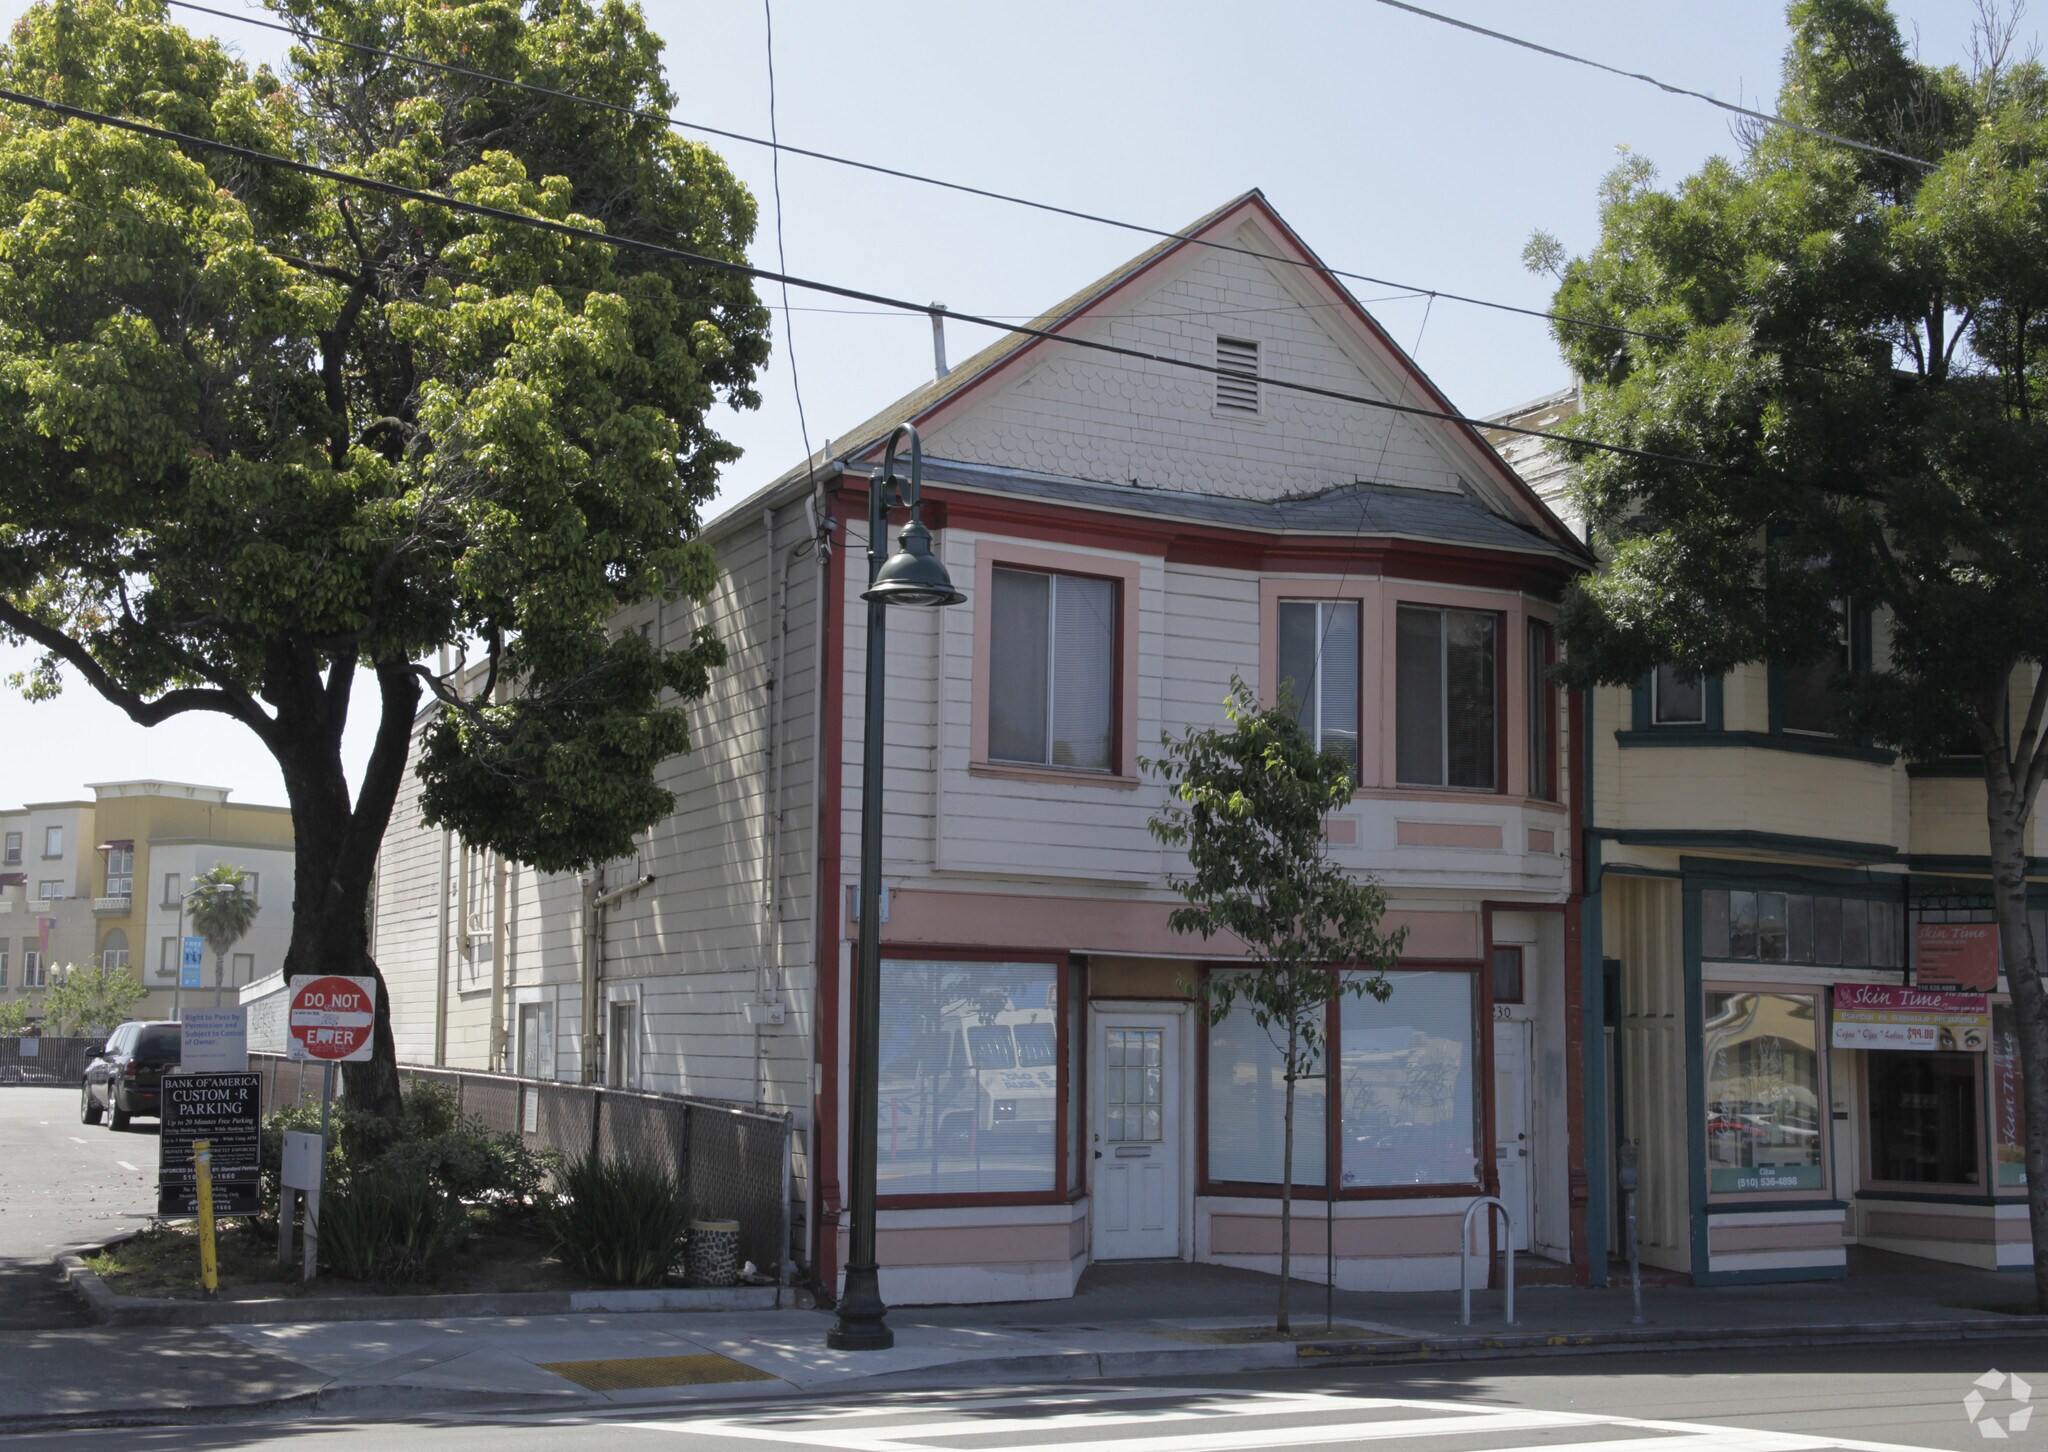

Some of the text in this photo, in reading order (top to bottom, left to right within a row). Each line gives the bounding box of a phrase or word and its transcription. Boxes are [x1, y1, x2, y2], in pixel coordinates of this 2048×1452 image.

[304, 993, 361, 1008] DO NOT
[1853, 985, 1943, 1007] Skin Time
[185, 1014, 204, 1022] Right
[231, 1014, 240, 1022] by
[185, 1030, 211, 1038] Subject
[307, 1030, 354, 1045] EER
[1907, 1027, 1934, 1040] $99.00
[165, 1077, 258, 1089] BANK OF AMERICA
[173, 1088, 248, 1102] CUSTOMR
[180, 1102, 242, 1115] PARKING
[232, 1117, 254, 1125] Parking
[1738, 1176, 1798, 1189] (510) 536-4898
